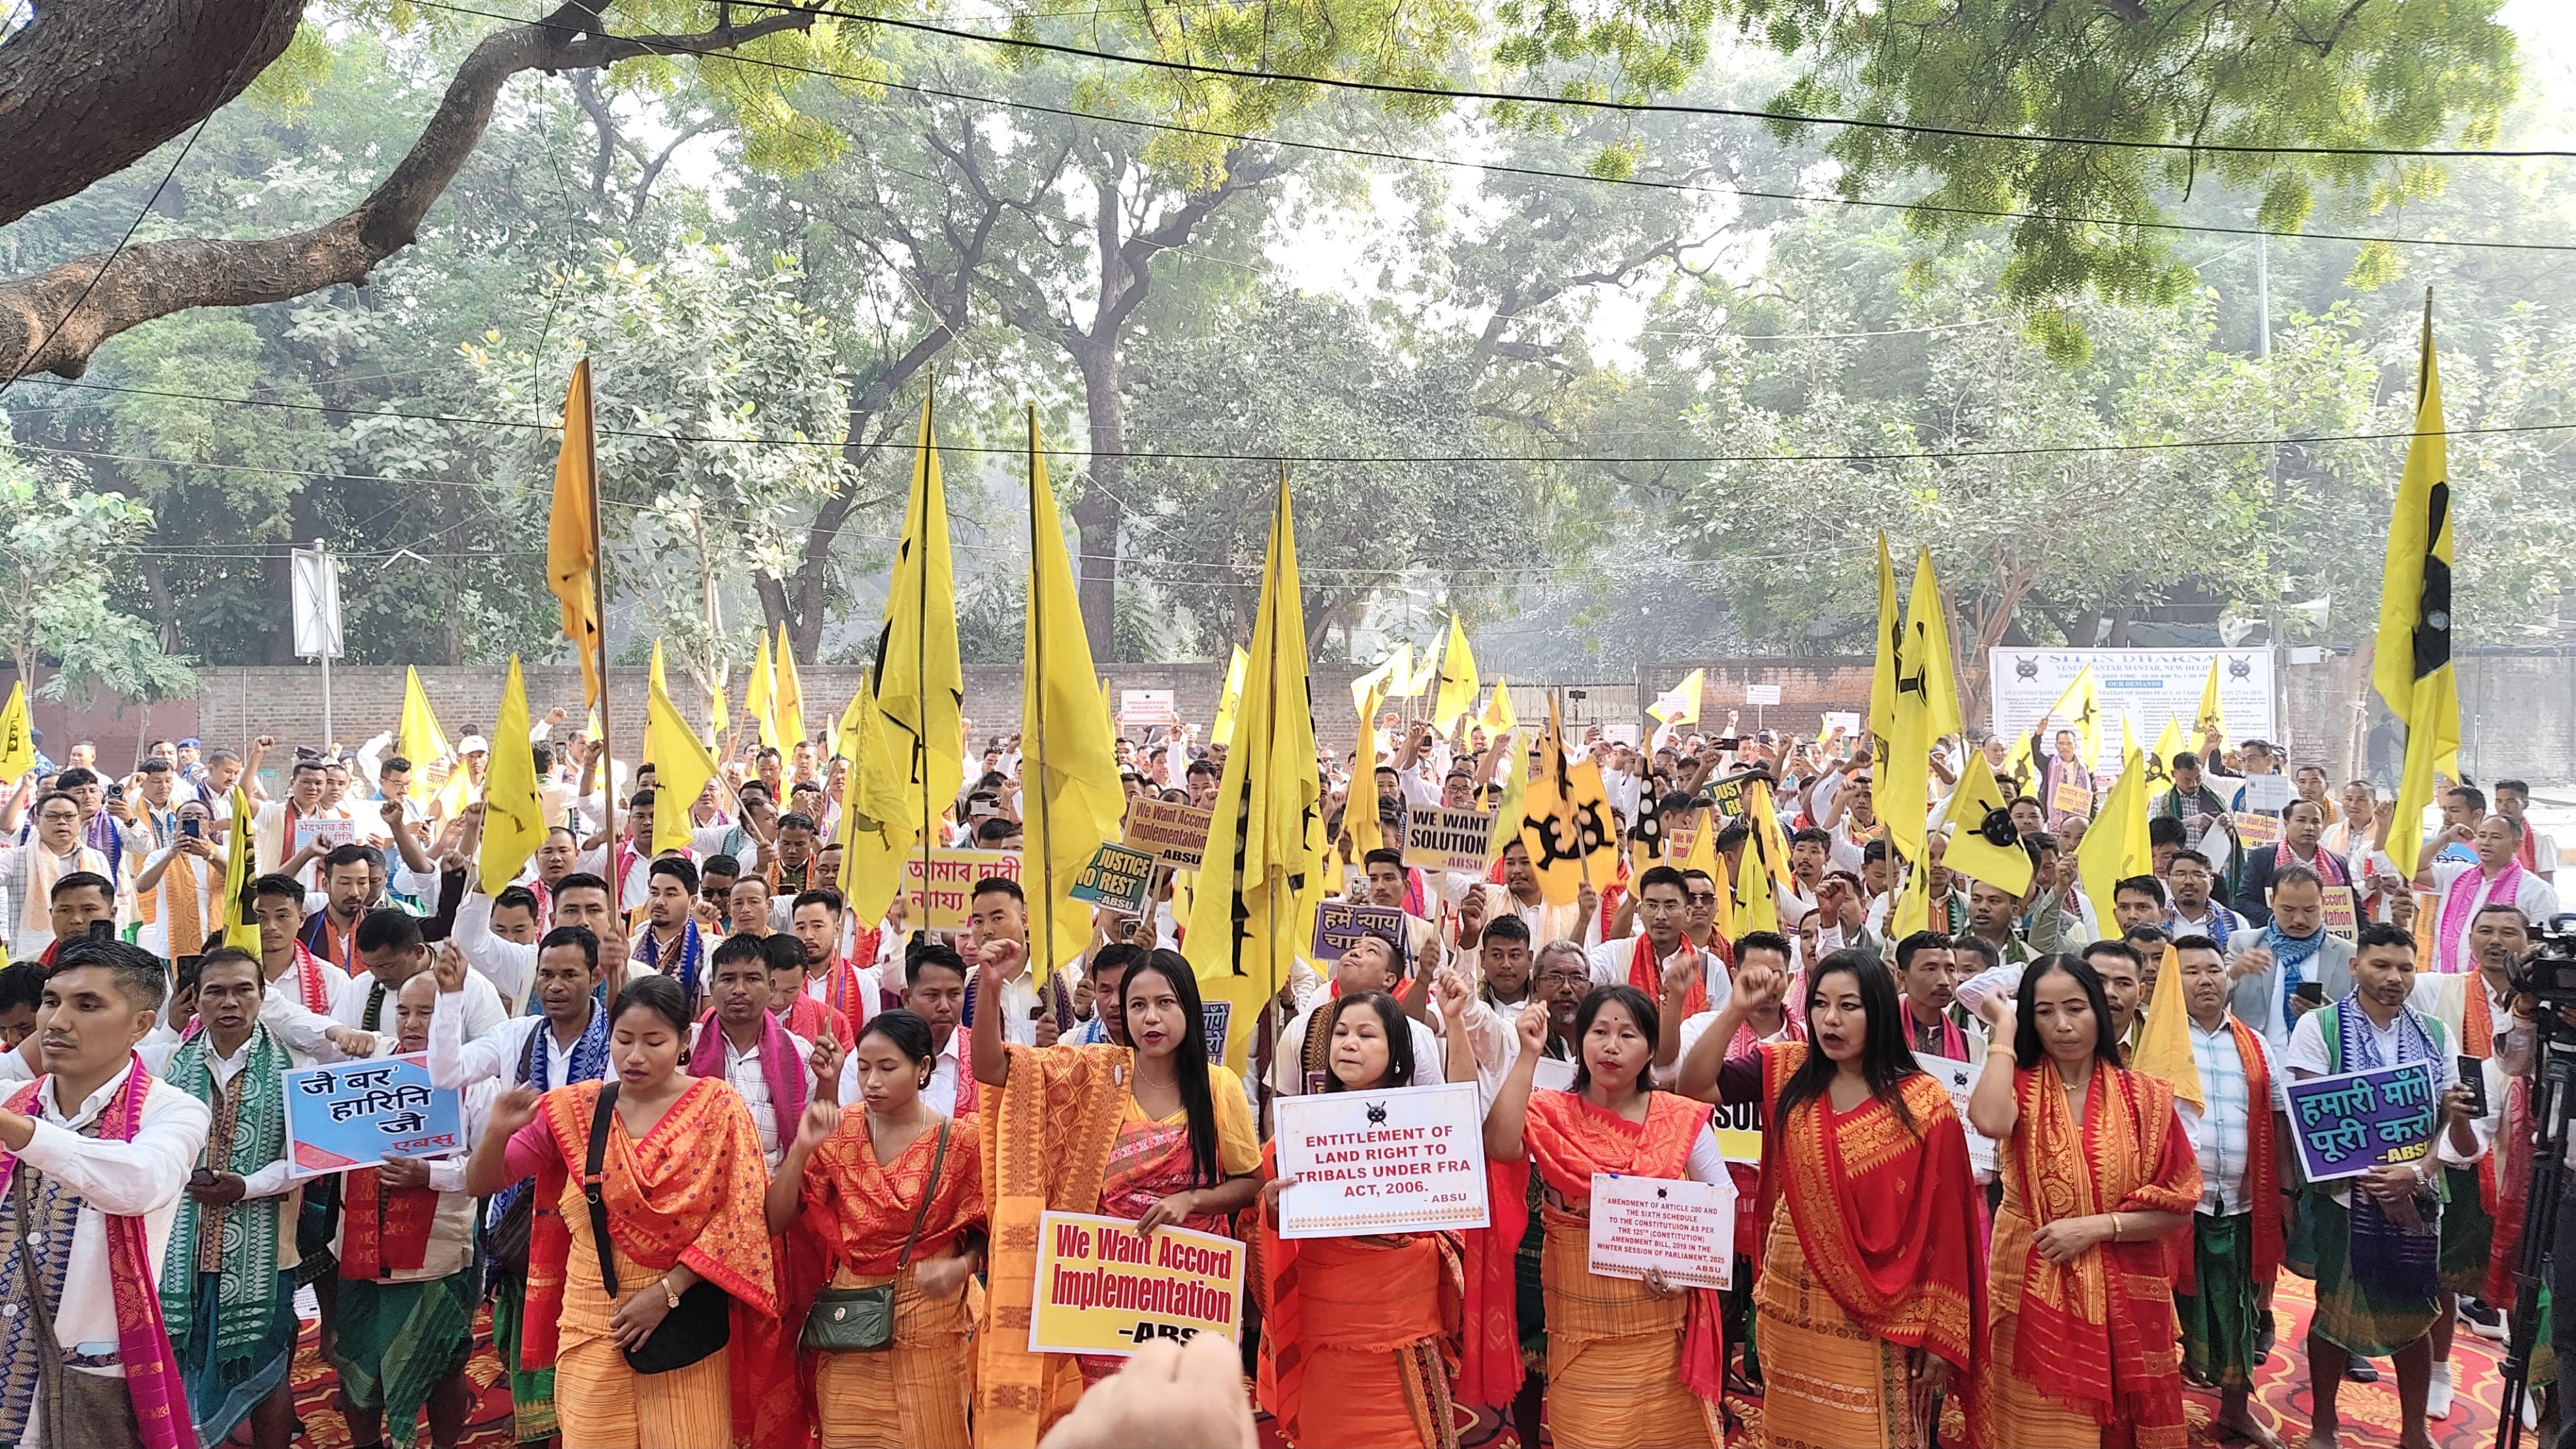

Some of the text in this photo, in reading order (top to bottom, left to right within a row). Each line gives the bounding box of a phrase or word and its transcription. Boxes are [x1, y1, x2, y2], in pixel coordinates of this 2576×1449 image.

[338, 820, 353, 832] की
[1135, 801, 1212, 830] We Want Accord
[1412, 809, 1490, 832] WE WANT
[2237, 814, 2245, 824] We
[1130, 819, 1208, 851] Implementation
[1410, 828, 1488, 855] SOLUTION
[1674, 832, 1684, 843] We
[1097, 848, 1151, 879] JUSTICE
[1156, 849, 1202, 865] -ABSU
[1442, 856, 1483, 870] -ABSU
[1098, 870, 1137, 898] REST
[1095, 895, 1135, 911] -ABSU
[1324, 907, 1399, 932] हमें न्याय
[300, 1071, 338, 1094] जै
[329, 1085, 432, 1122] हारिनि
[2296, 1077, 2377, 1128] हमारी
[378, 1112, 426, 1133] जै
[2307, 1105, 2433, 1162] पूरी करो
[1306, 1125, 1454, 1148] ENTITLEMENT OF
[1314, 1143, 1447, 1164] LAND RIGHT TO
[1295, 1160, 1471, 1183] TRIBALS UNDER FRA
[1344, 1180, 1429, 1197] ACT, 2006.
[1431, 1192, 1467, 1203] ABSU
[1607, 1197, 1649, 1209] AMENDMENT
[1661, 1203, 1689, 1212] ARTICLE
[1626, 1209, 1698, 1223] THE SIXTH SCHEDULE
[1611, 1235, 1653, 1246] AMENDMENT
[1654, 1241, 1671, 1249] BILL,
[1650, 1231, 1705, 1244] (CONSTITUTION)
[1056, 1224, 1233, 1280] We Want Accord
[1597, 1243, 1623, 1252] WINTER
[1624, 1245, 1653, 1256] SESSION
[1665, 1251, 1709, 1263] PARLIAMENT,
[1710, 1256, 1725, 1264] 2025
[1695, 1265, 1721, 1273] ABSU
[1051, 1263, 1232, 1325] Implementation
[1118, 1321, 1226, 1348] -ABS
